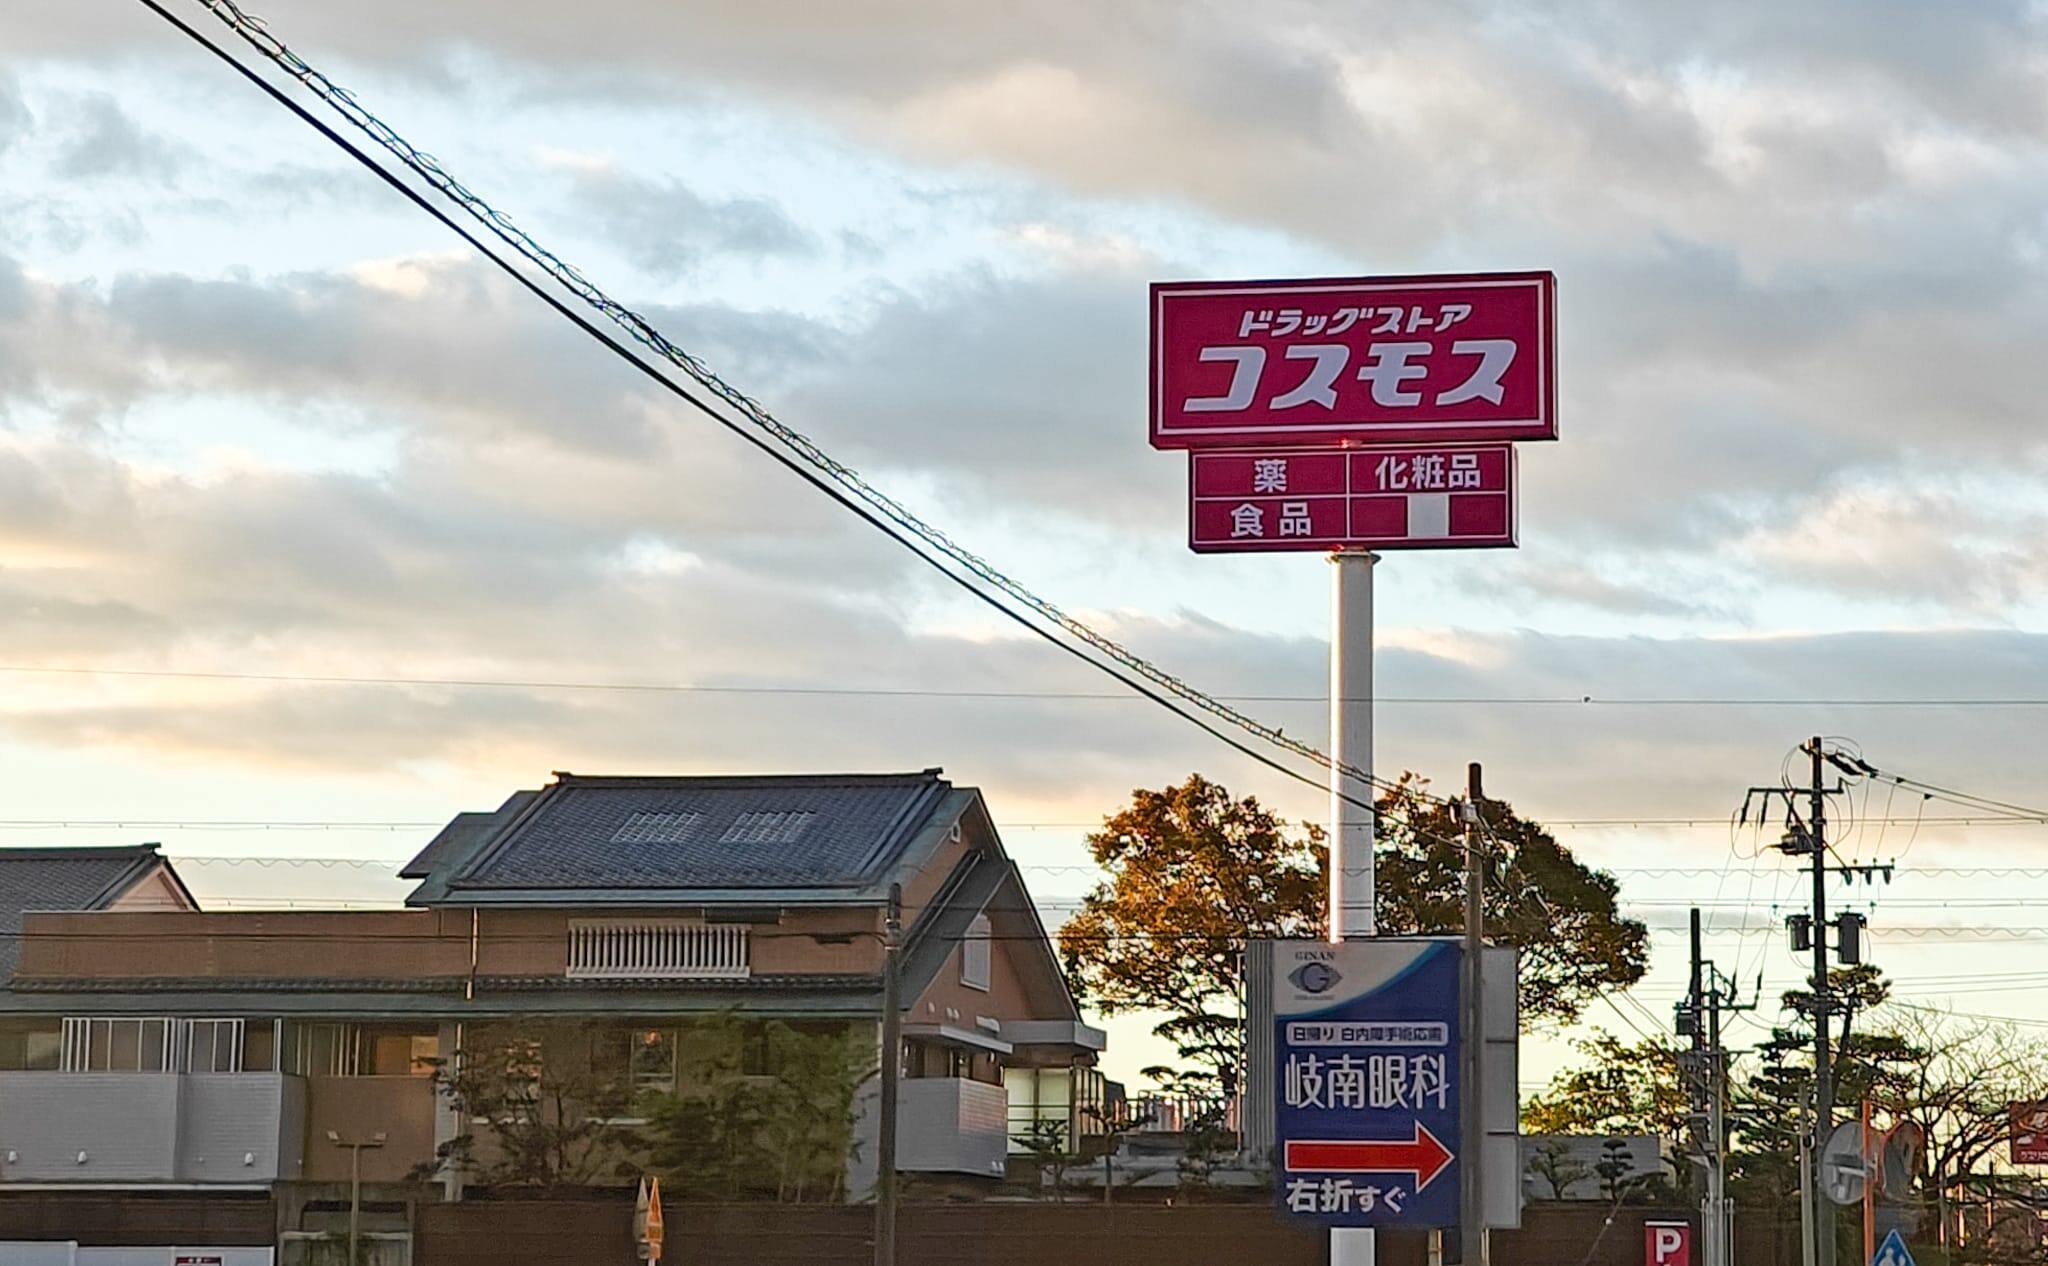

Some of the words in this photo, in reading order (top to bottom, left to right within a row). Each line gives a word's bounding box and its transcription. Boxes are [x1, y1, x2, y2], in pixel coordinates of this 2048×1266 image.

[1238, 304, 1472, 338] ドラッグストア
[1183, 339, 1517, 413] コスモス
[1254, 459, 1287, 493] 薬
[1375, 454, 1481, 489] 化粧品
[1230, 502, 1312, 538] 食品
[1294, 951, 1336, 961] GINAN
[1285, 1053, 1450, 1110] 岐南眼科
[1286, 1178, 1407, 1214] 右折すぐ
[1655, 1228, 1681, 1263] P
